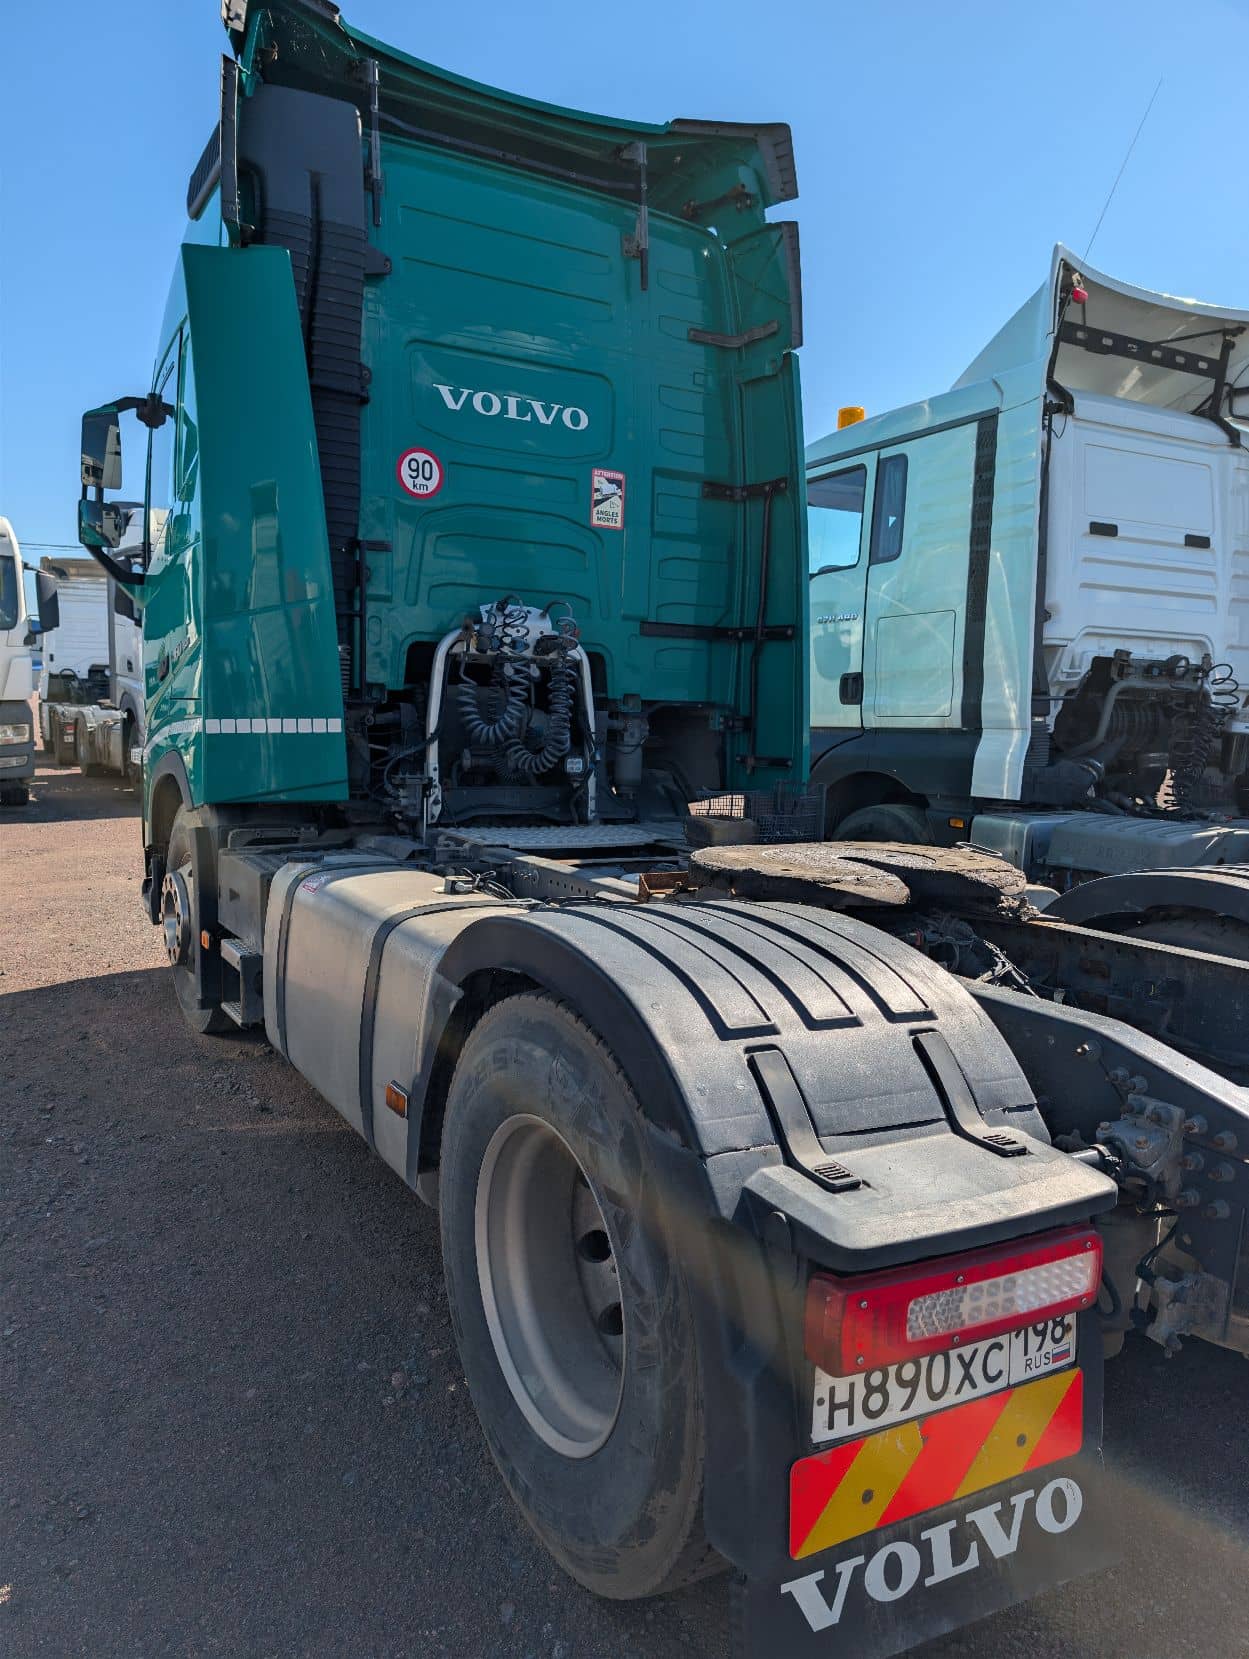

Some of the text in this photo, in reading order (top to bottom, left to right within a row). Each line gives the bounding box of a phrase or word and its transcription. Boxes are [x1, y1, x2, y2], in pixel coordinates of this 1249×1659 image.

[433, 383, 589, 431] VOLVO
[408, 458, 433, 481] 90
[413, 480, 428, 491] km
[596, 510, 619, 518] ANGLES
[597, 516, 618, 524] MORTS
[1015, 1315, 1066, 1357] 198
[1025, 1352, 1051, 1374] RUS
[781, 1477, 1083, 1633] VOLVO
